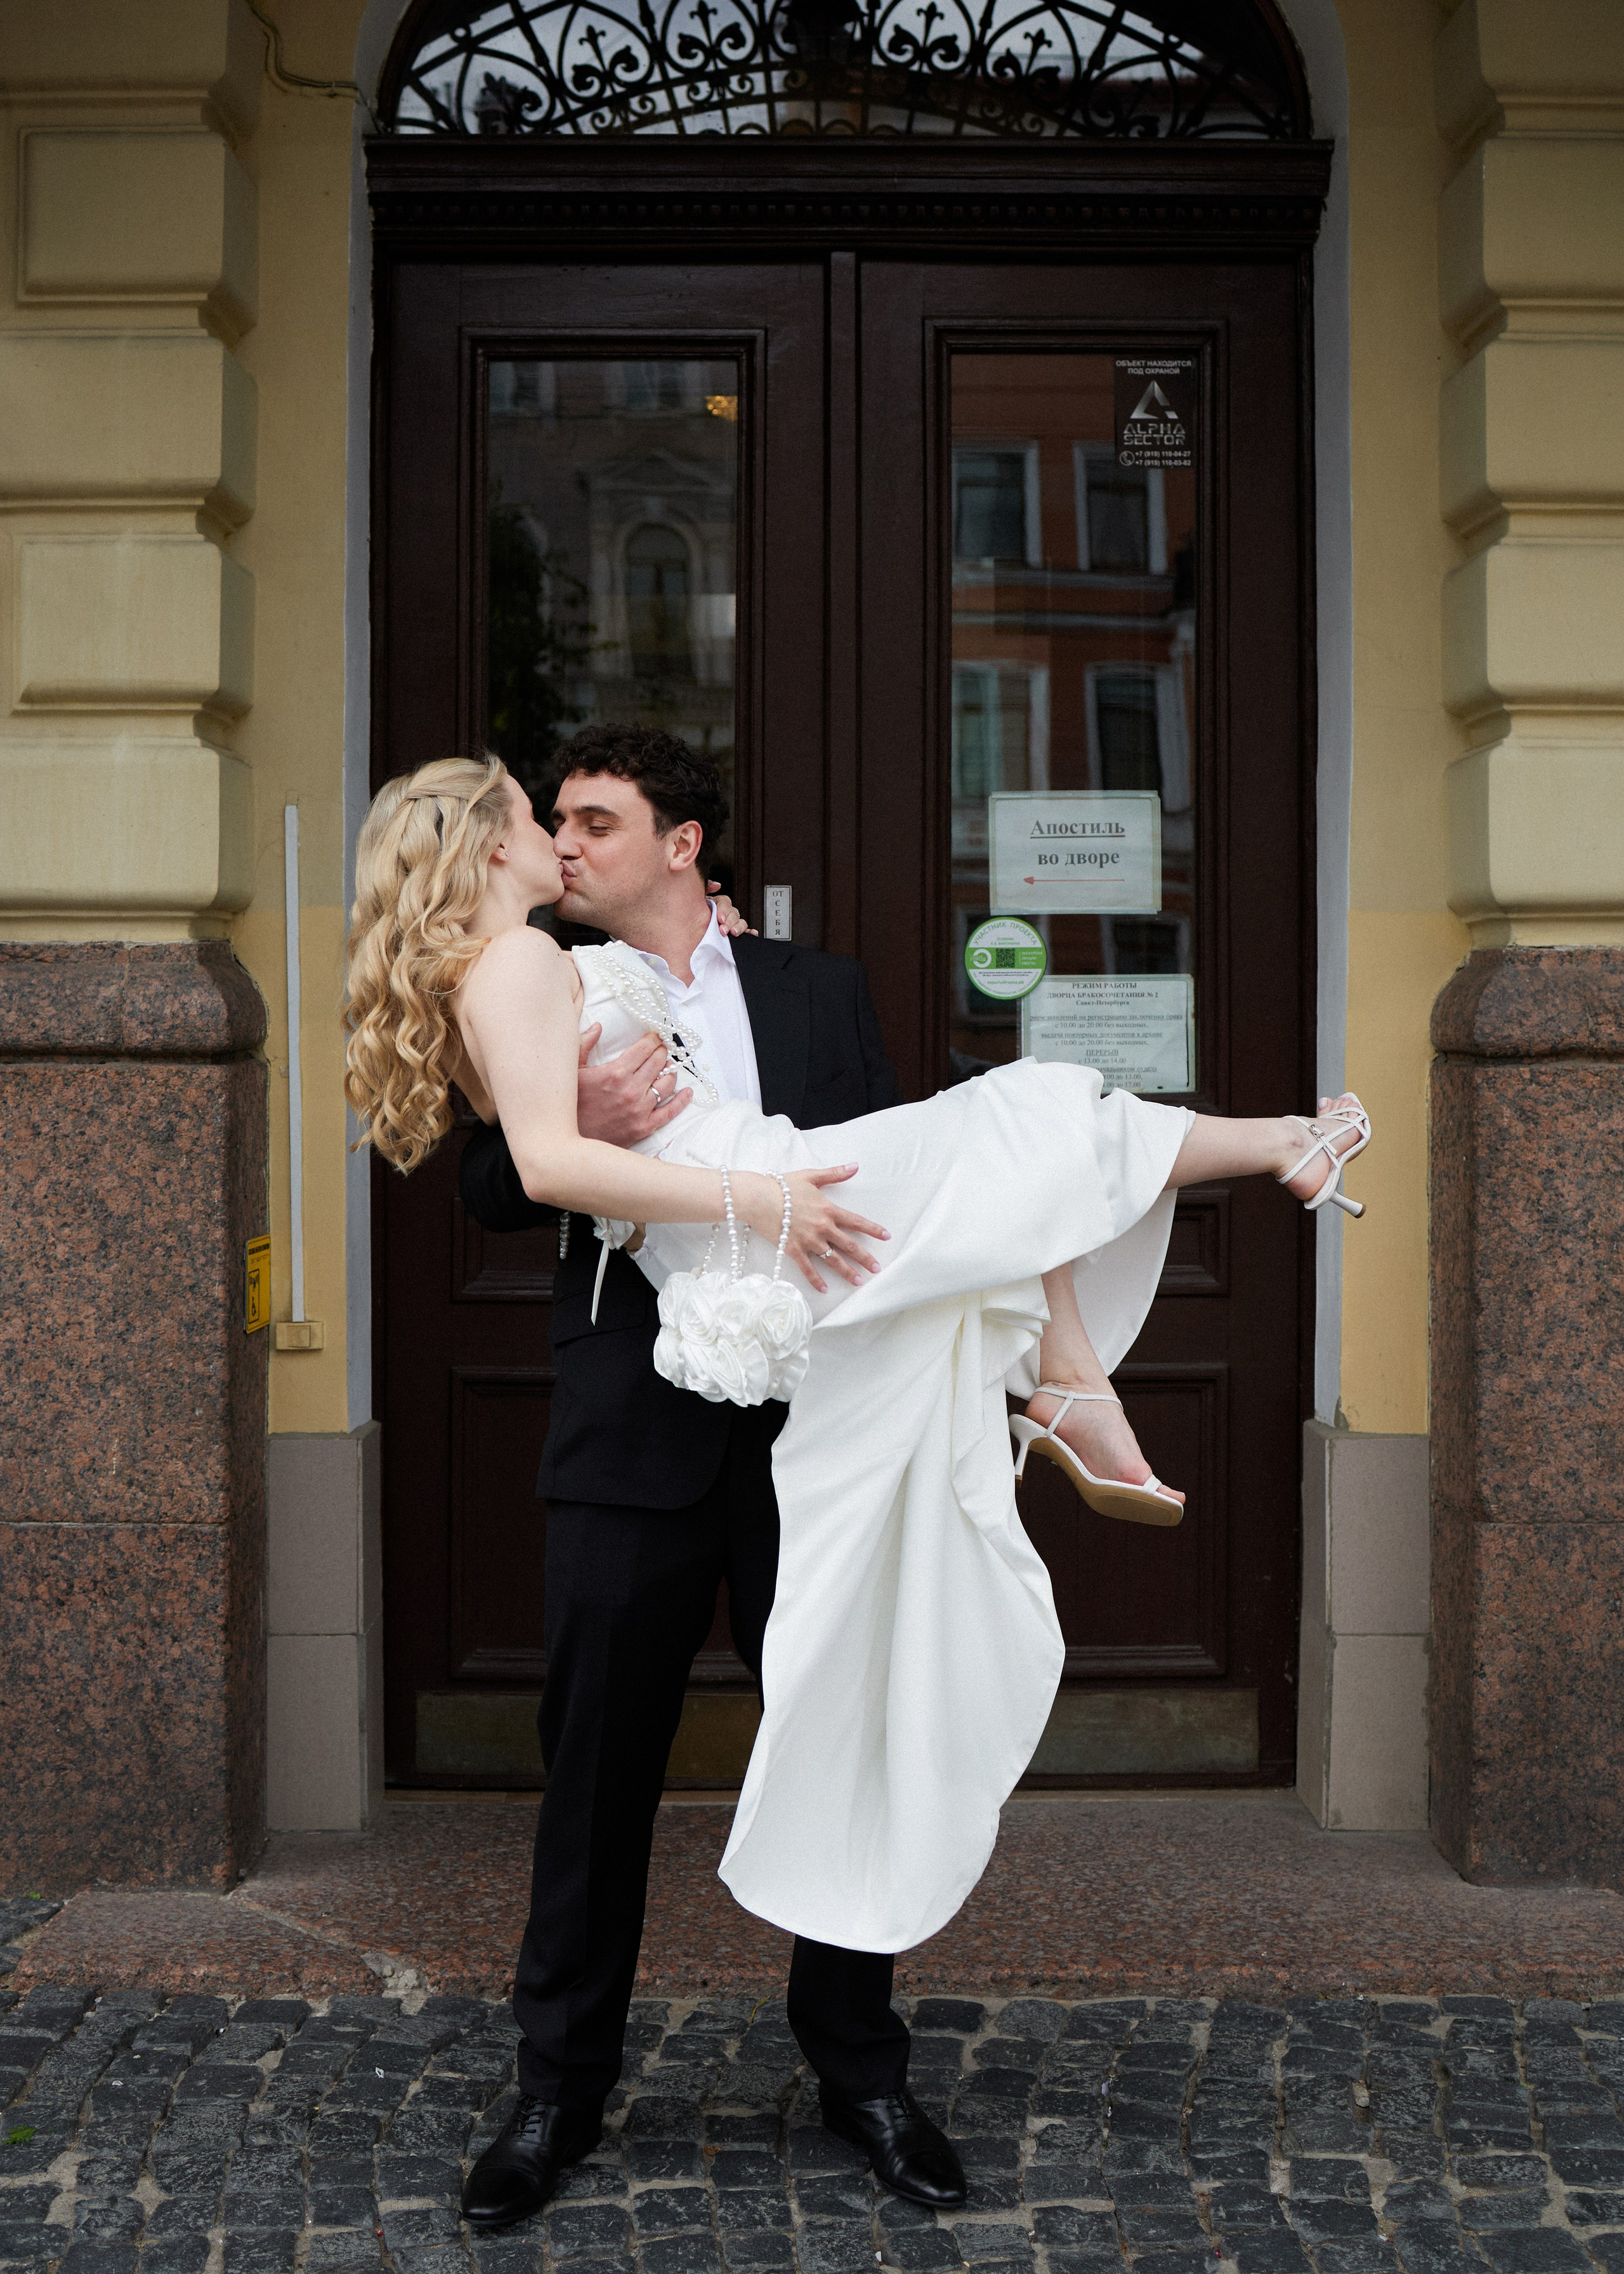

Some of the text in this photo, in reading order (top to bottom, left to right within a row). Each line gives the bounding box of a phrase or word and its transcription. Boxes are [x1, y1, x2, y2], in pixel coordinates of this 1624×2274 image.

[1123, 423, 1186, 434] ALPHA
[1123, 435, 1186, 445] SECTOR
[1030, 819, 1125, 836] Апостиль
[1038, 851, 1120, 869] во дворе
[972, 922, 1037, 945] УЧАСТНИК ПРОЕКТА
